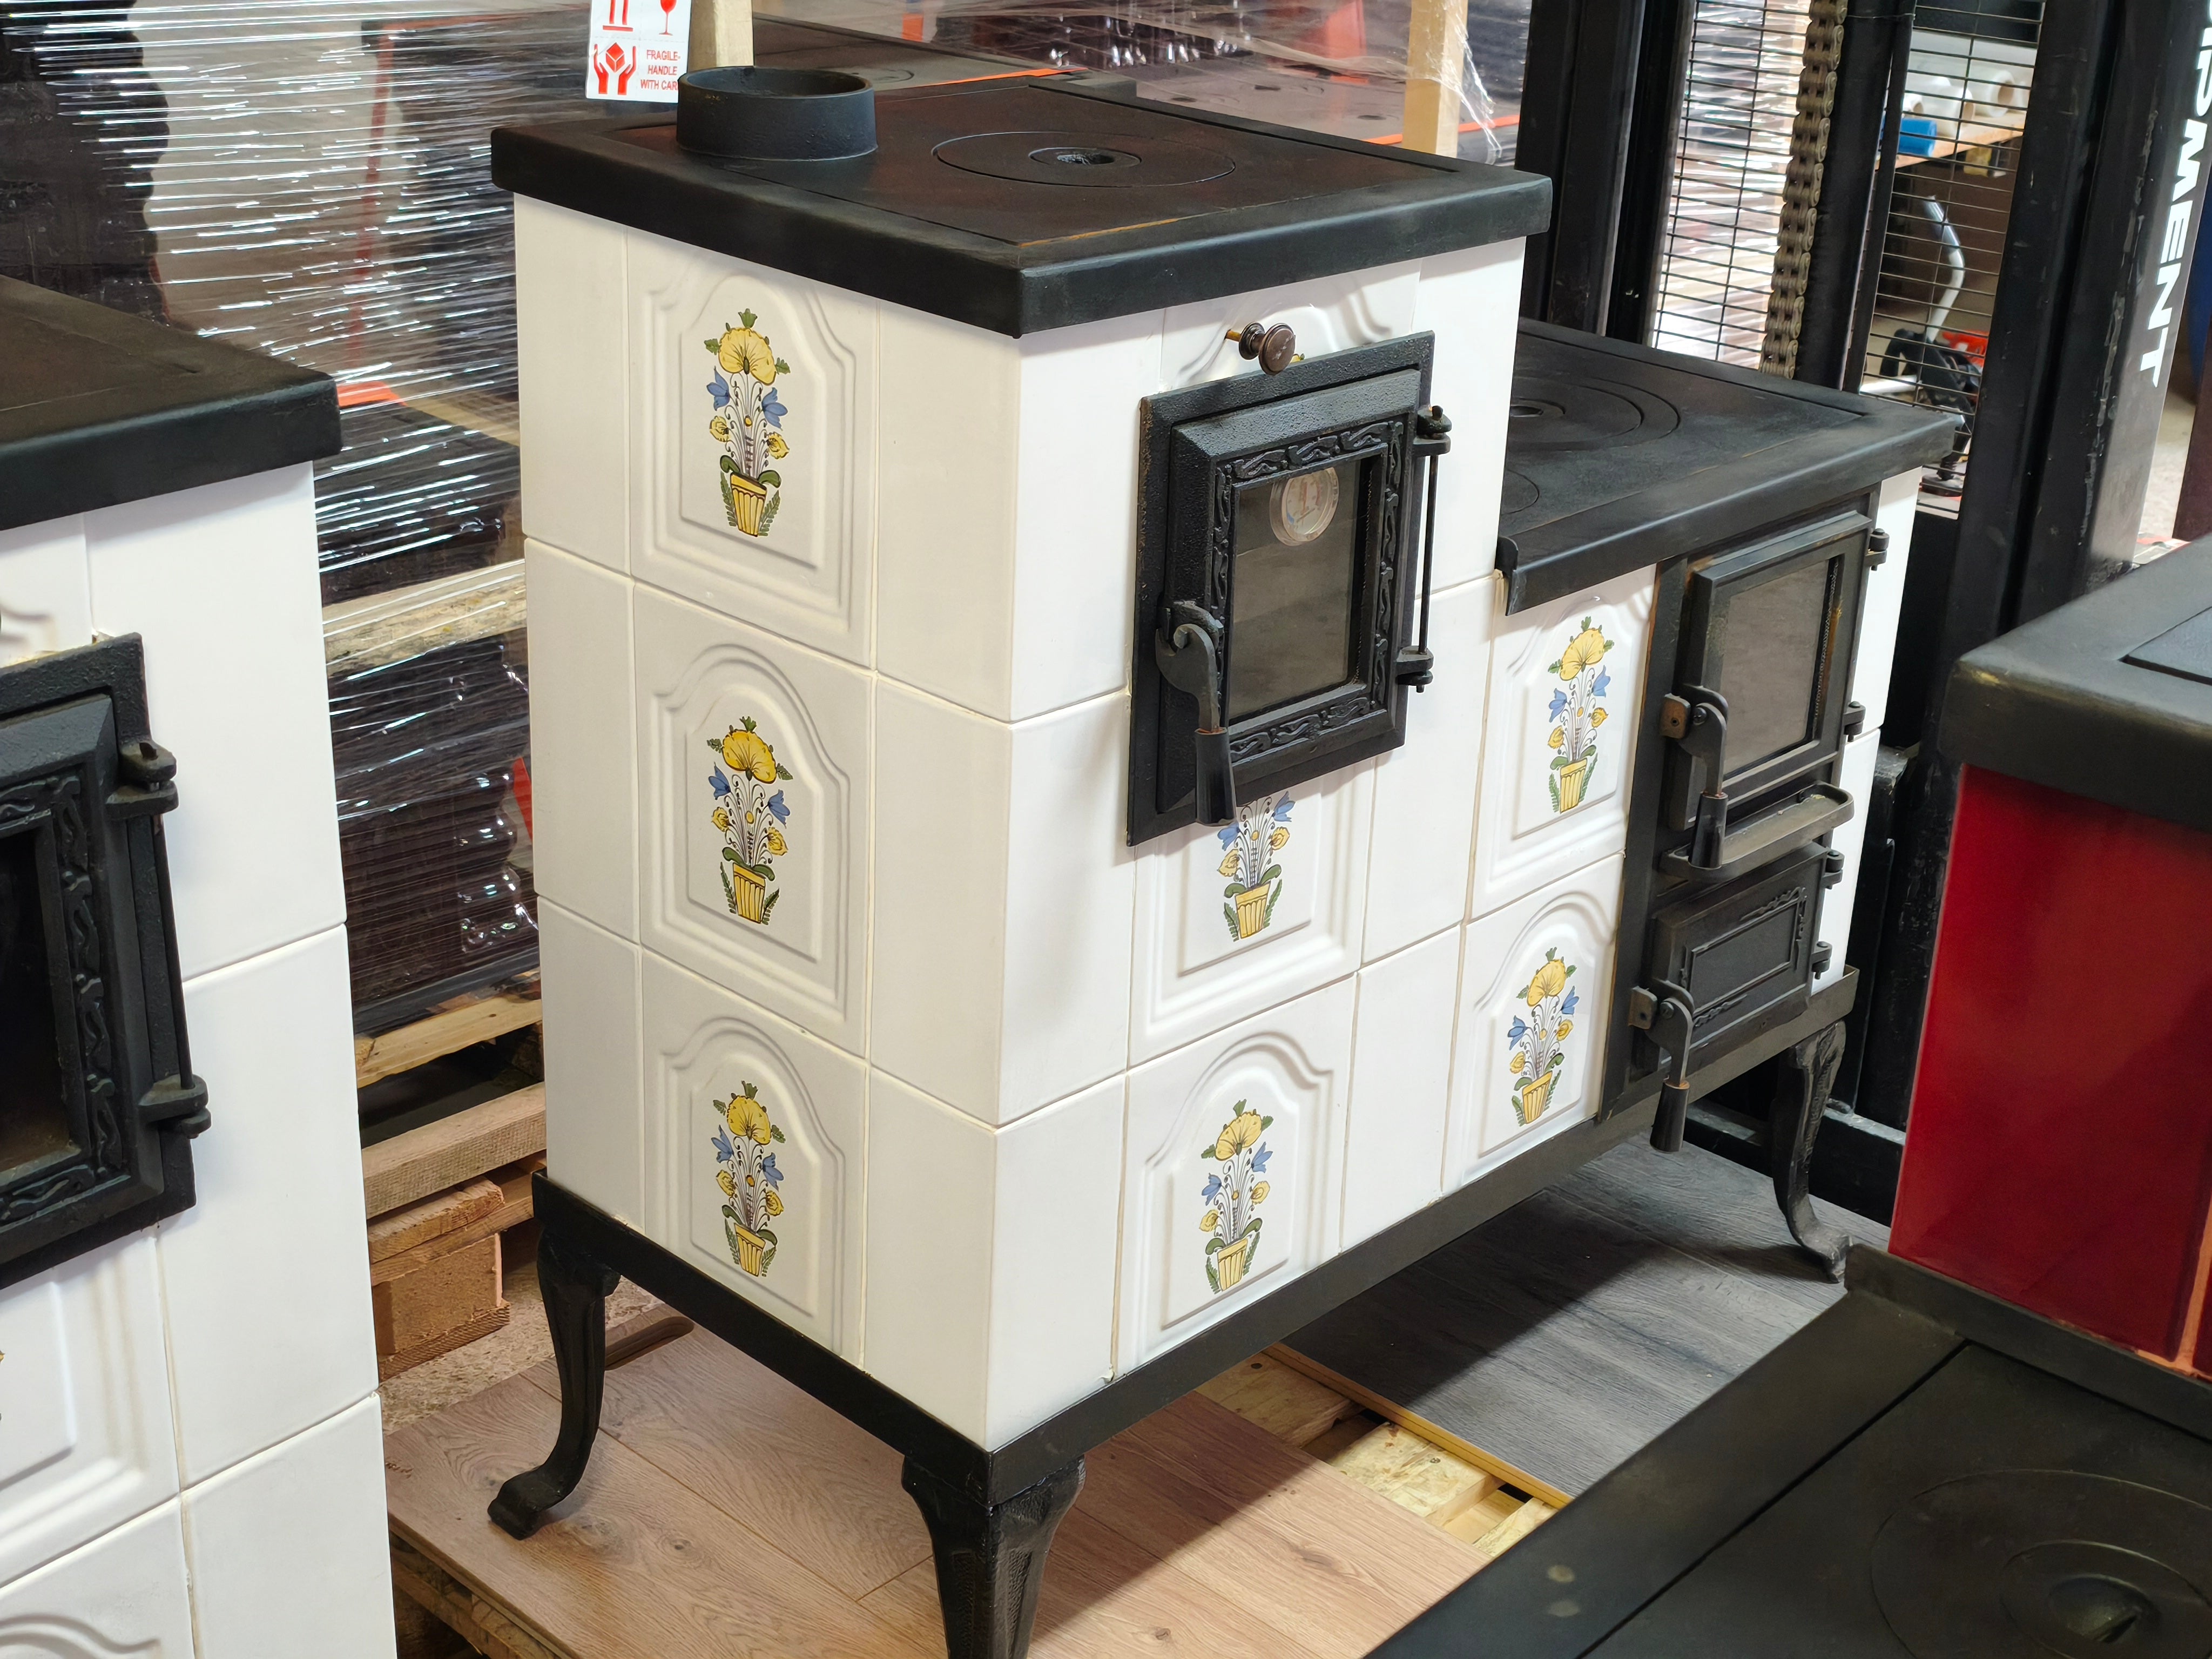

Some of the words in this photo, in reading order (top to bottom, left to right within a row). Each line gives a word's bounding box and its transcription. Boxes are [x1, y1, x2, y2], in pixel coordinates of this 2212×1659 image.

[648, 65, 678, 75] HANDLE
[640, 79, 659, 90] WITH
[661, 80, 679, 91] CAR
[2140, 0, 2212, 387] PMENT
